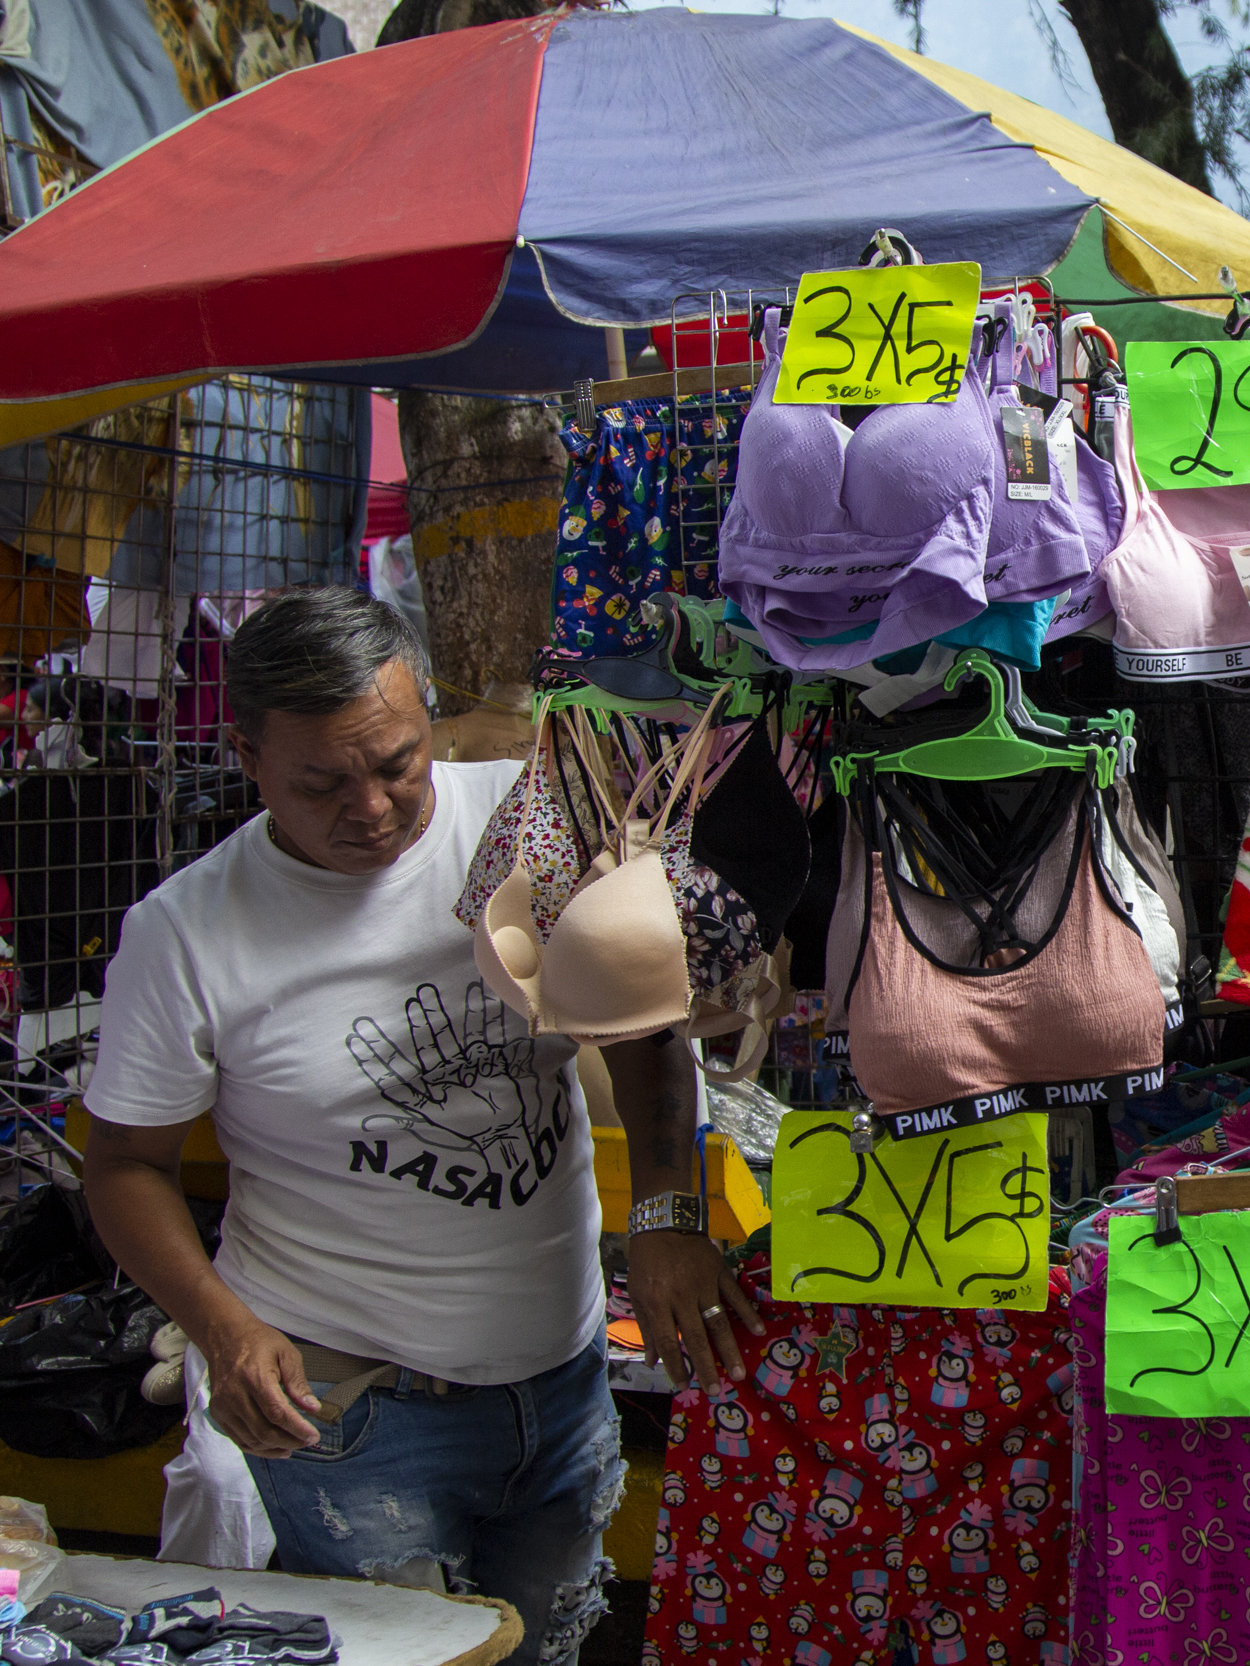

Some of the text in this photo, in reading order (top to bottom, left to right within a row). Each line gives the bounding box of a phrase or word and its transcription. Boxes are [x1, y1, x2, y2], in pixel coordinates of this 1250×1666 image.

[1022, 422, 1035, 475] VICBLACK
[772, 559, 911, 581] your secr
[1126, 657, 1187, 673] YOURSELF
[1225, 653, 1243, 667] BE
[823, 1034, 850, 1055] PIM
[895, 1067, 1164, 1136] PIMK PIMK PIMK PIM
[990, 1288, 1017, 1305] 300
